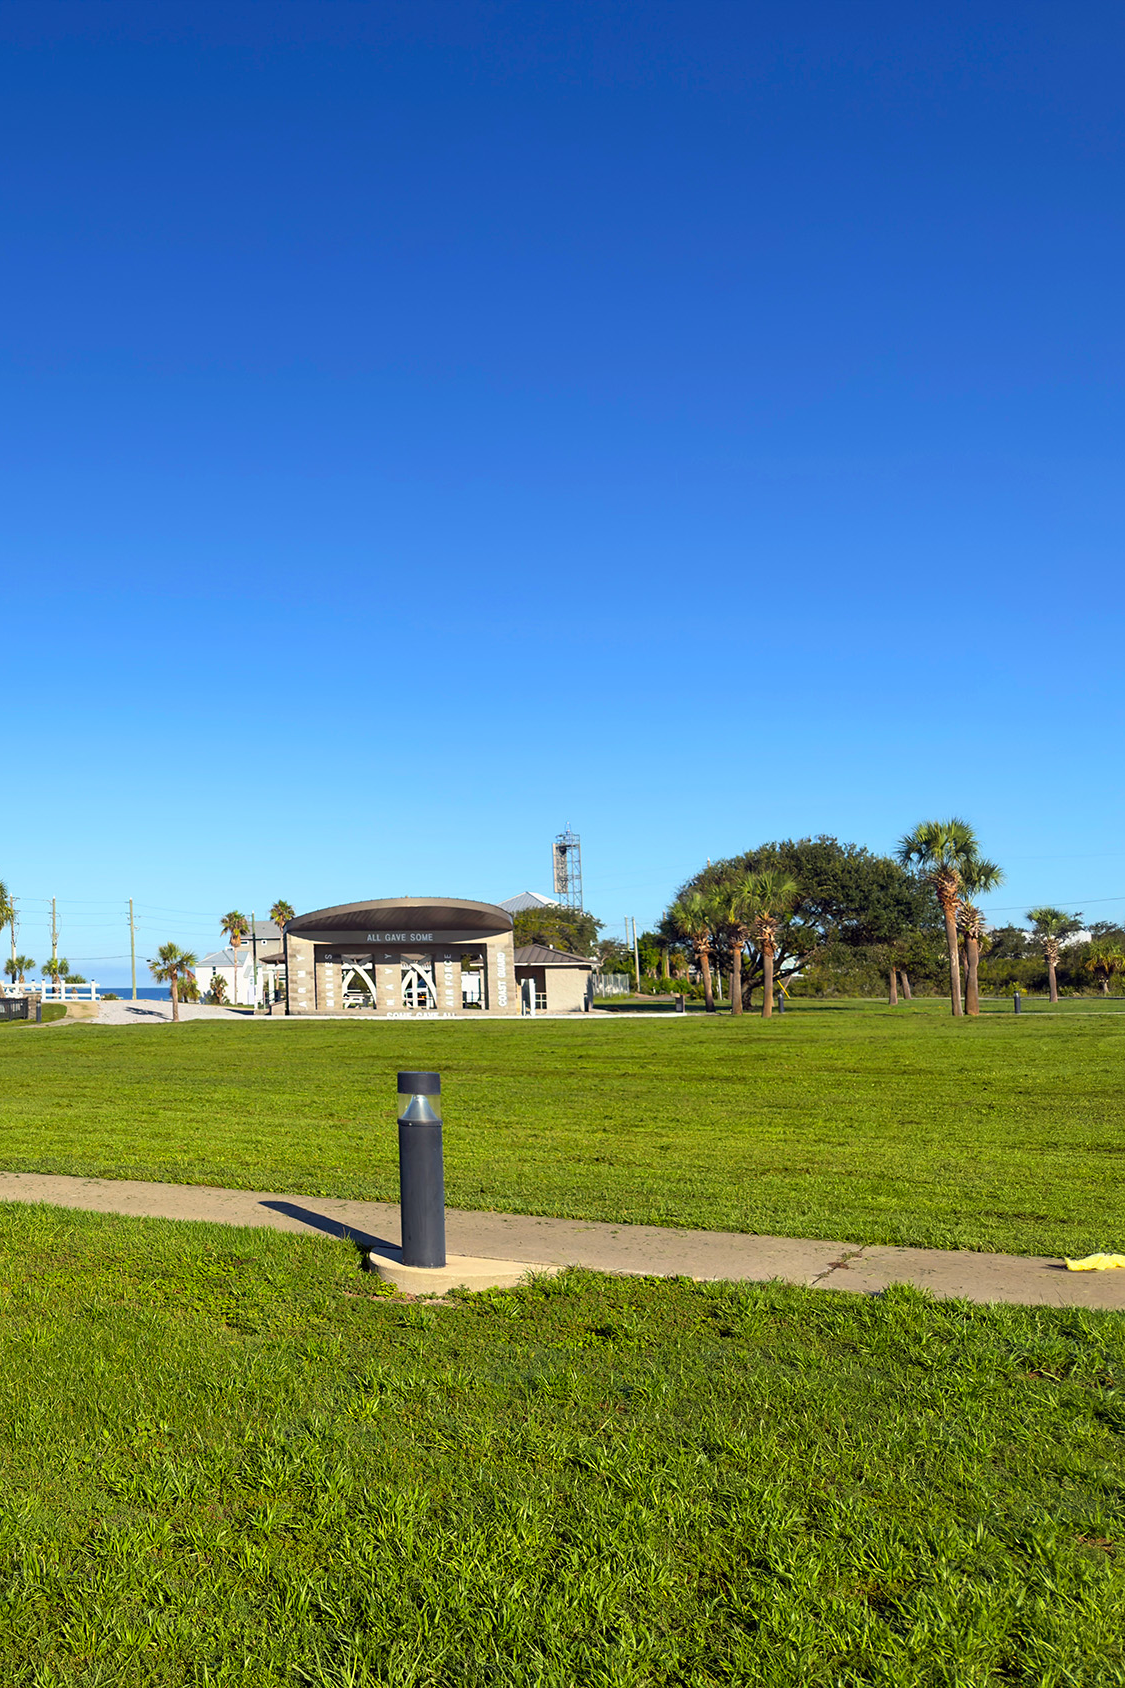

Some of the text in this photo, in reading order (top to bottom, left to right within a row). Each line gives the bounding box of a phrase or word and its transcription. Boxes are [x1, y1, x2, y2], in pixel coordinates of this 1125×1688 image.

[367, 933, 433, 942] ALL GAVE SOME
[296, 955, 307, 1008] ARMY
[324, 954, 335, 1007] MARINES
[384, 953, 395, 1006] NAVY
[443, 953, 455, 1007] AIR FORCE
[496, 951, 507, 1007] COAST GUARD
